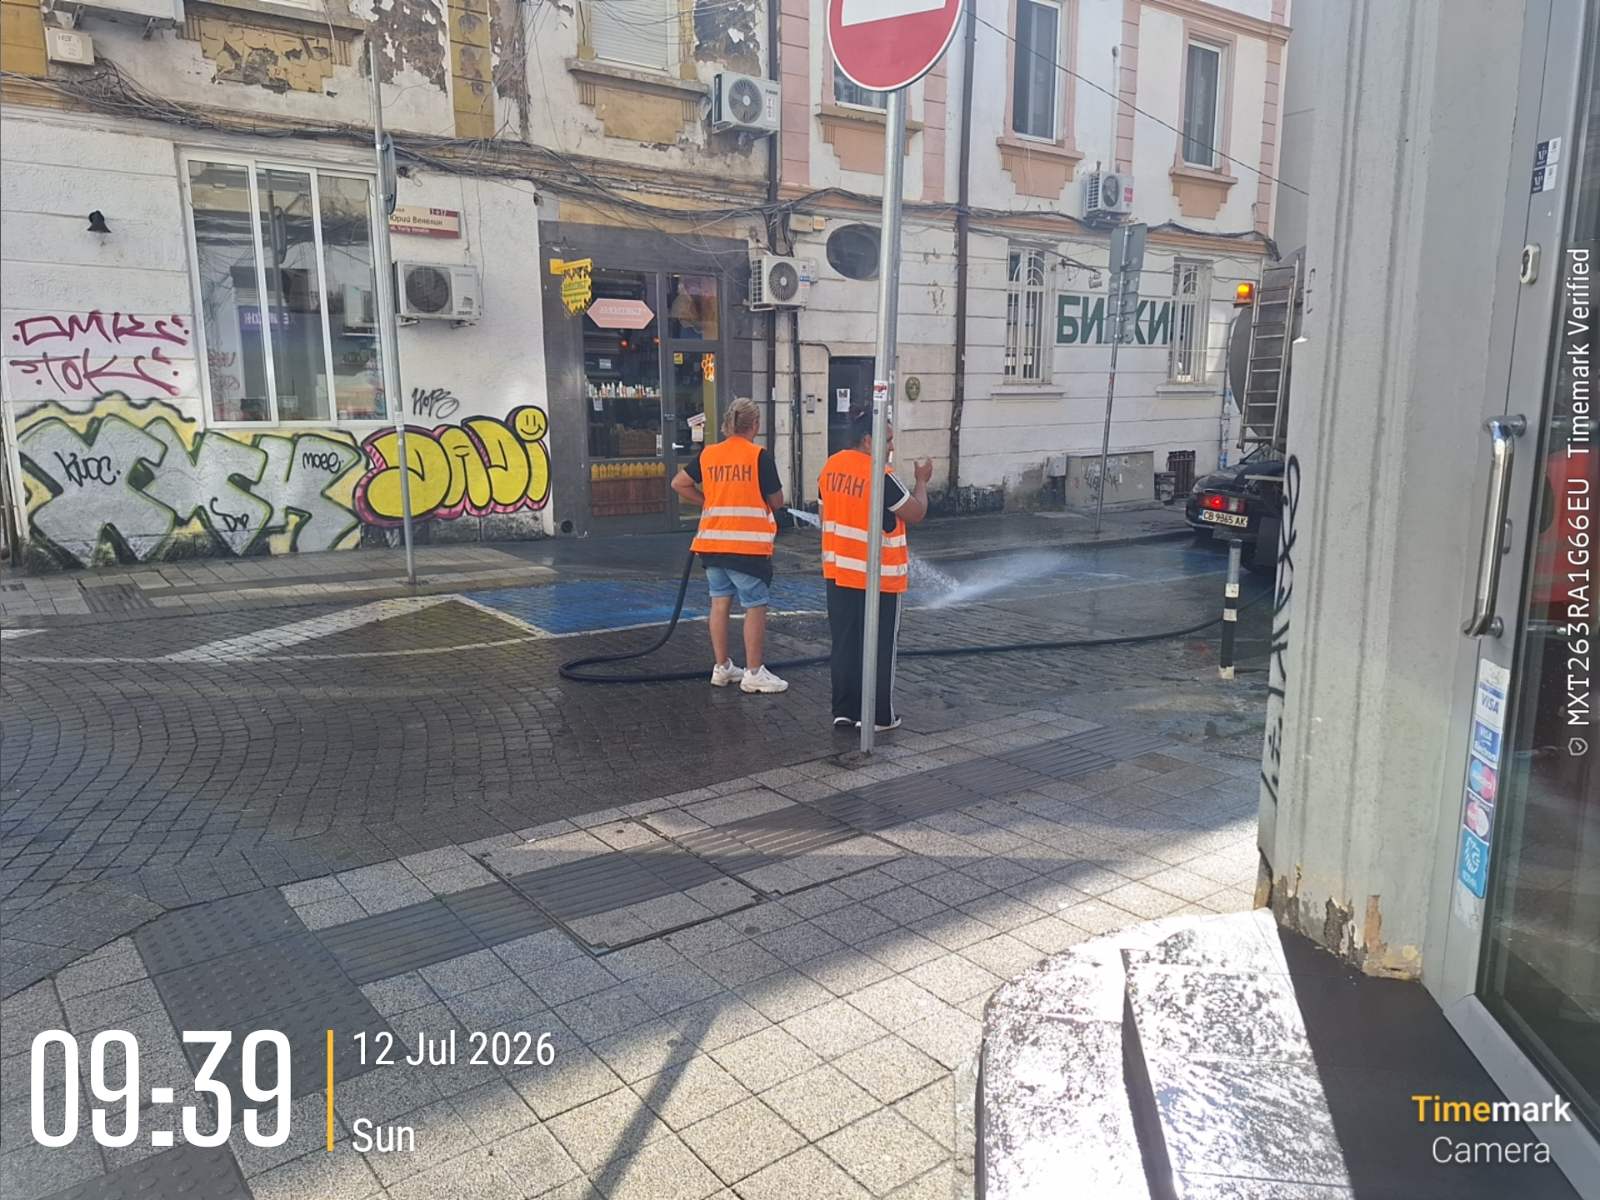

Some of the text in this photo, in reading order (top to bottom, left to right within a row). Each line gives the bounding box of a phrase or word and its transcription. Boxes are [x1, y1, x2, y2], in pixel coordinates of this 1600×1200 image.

[1056, 294, 1171, 345] БИКИ
[707, 464, 752, 482] ТИТАН
[827, 472, 865, 498] ТИТАН
[1481, 692, 1500, 715] VISA
